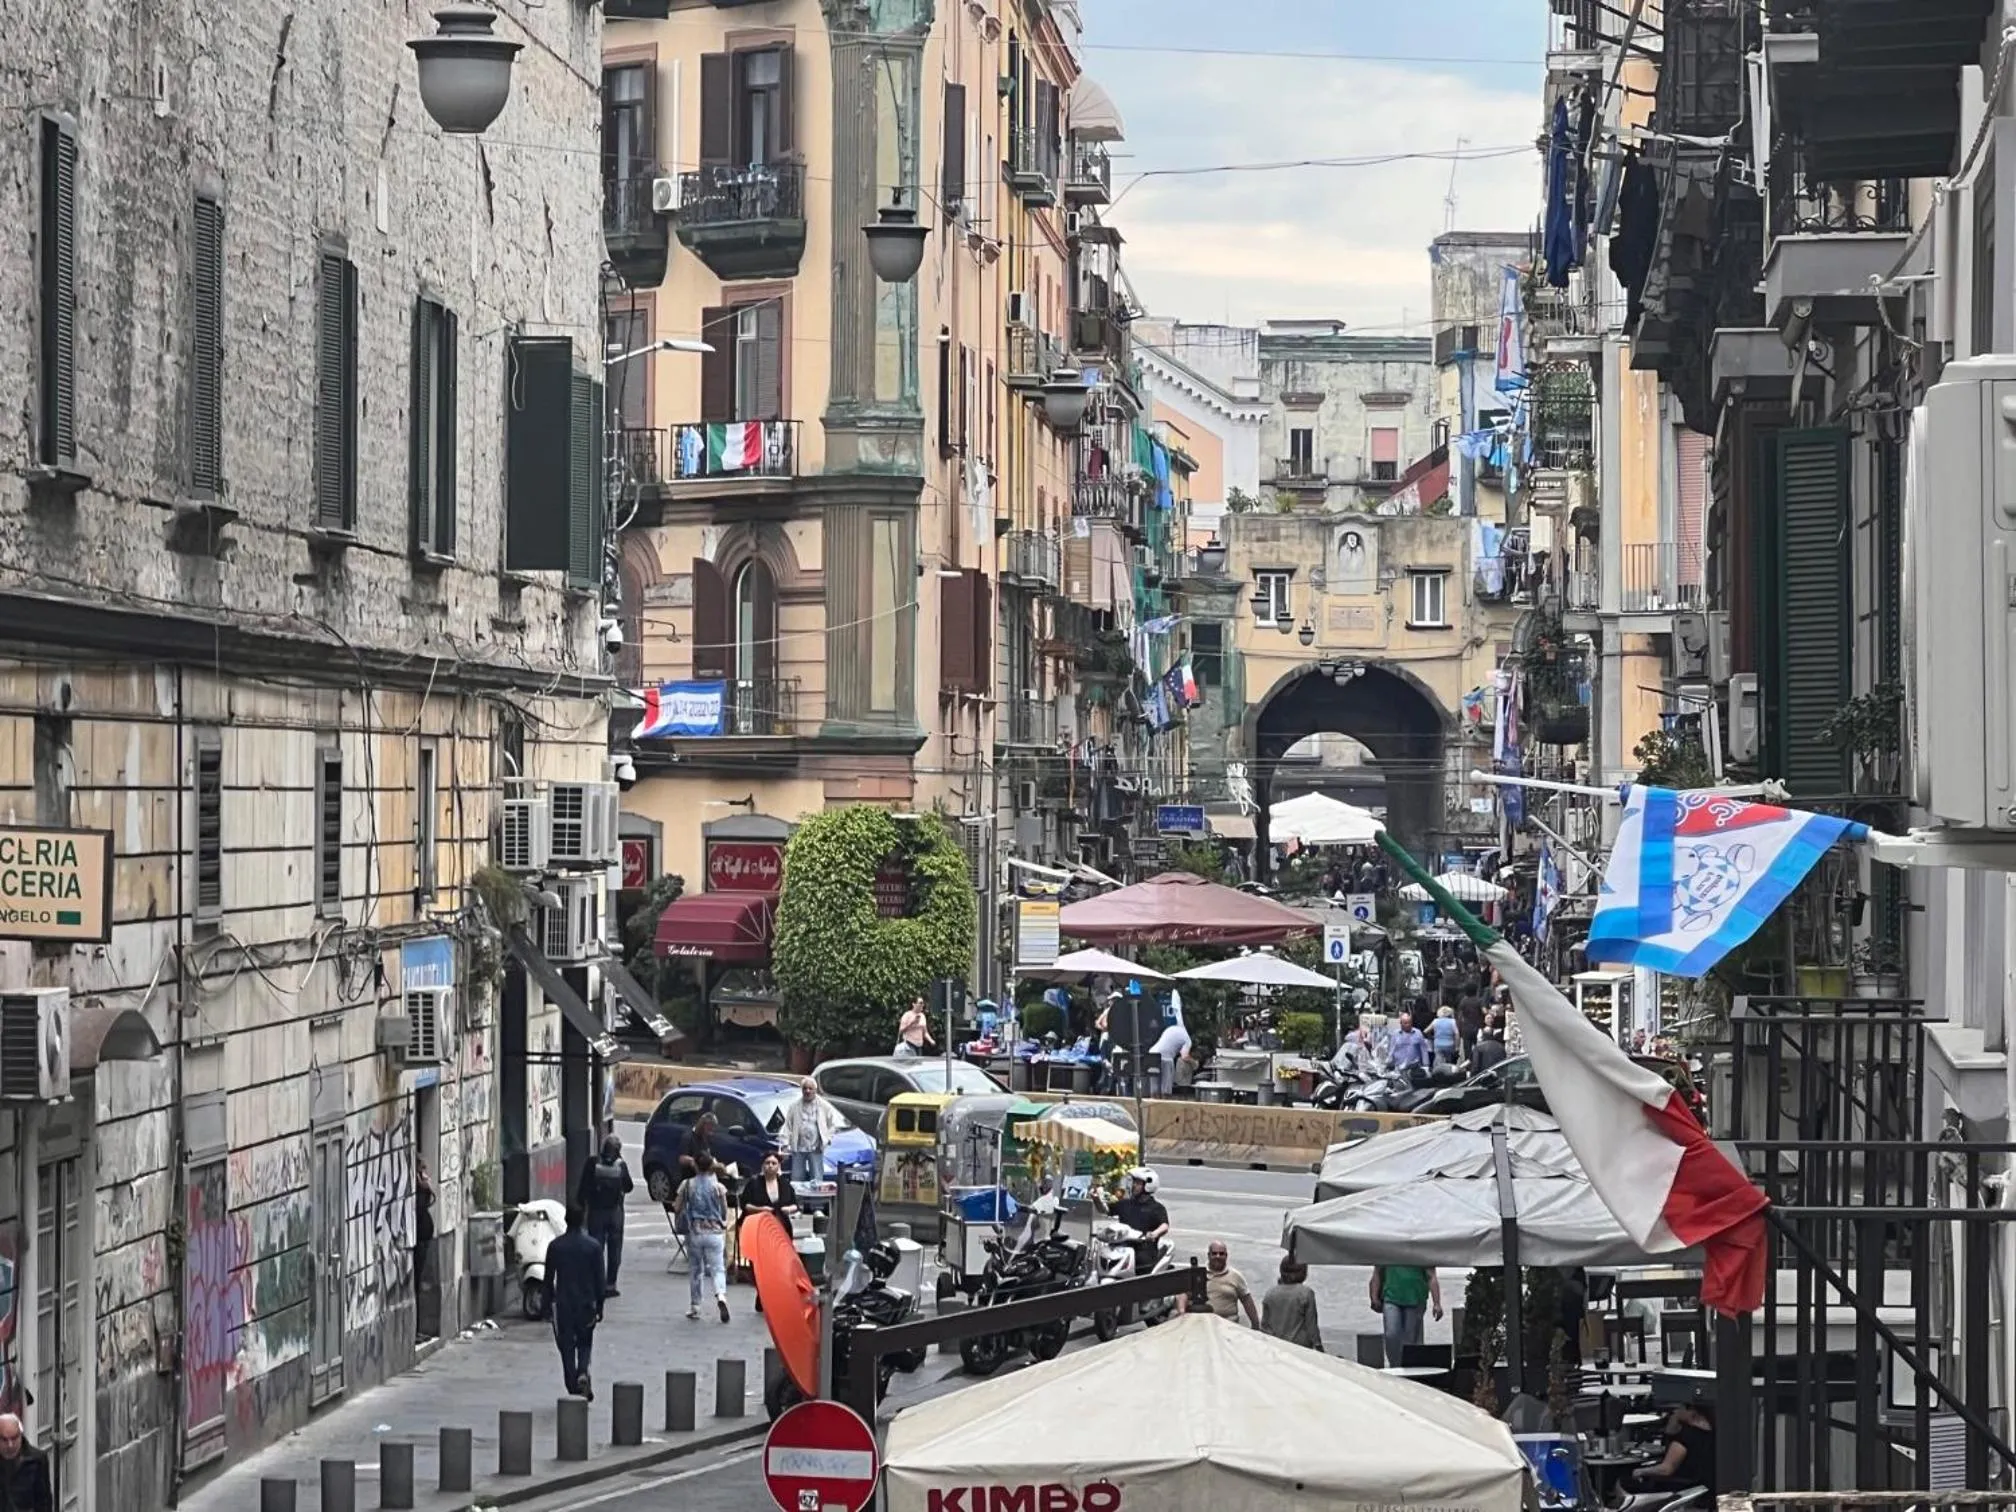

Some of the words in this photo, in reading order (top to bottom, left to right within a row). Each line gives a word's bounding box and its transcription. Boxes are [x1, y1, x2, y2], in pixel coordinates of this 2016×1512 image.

[1, 869, 82, 899] CERIA
[667, 944, 714, 957] Gelateria
[928, 1483, 1121, 1512] KIMBO
